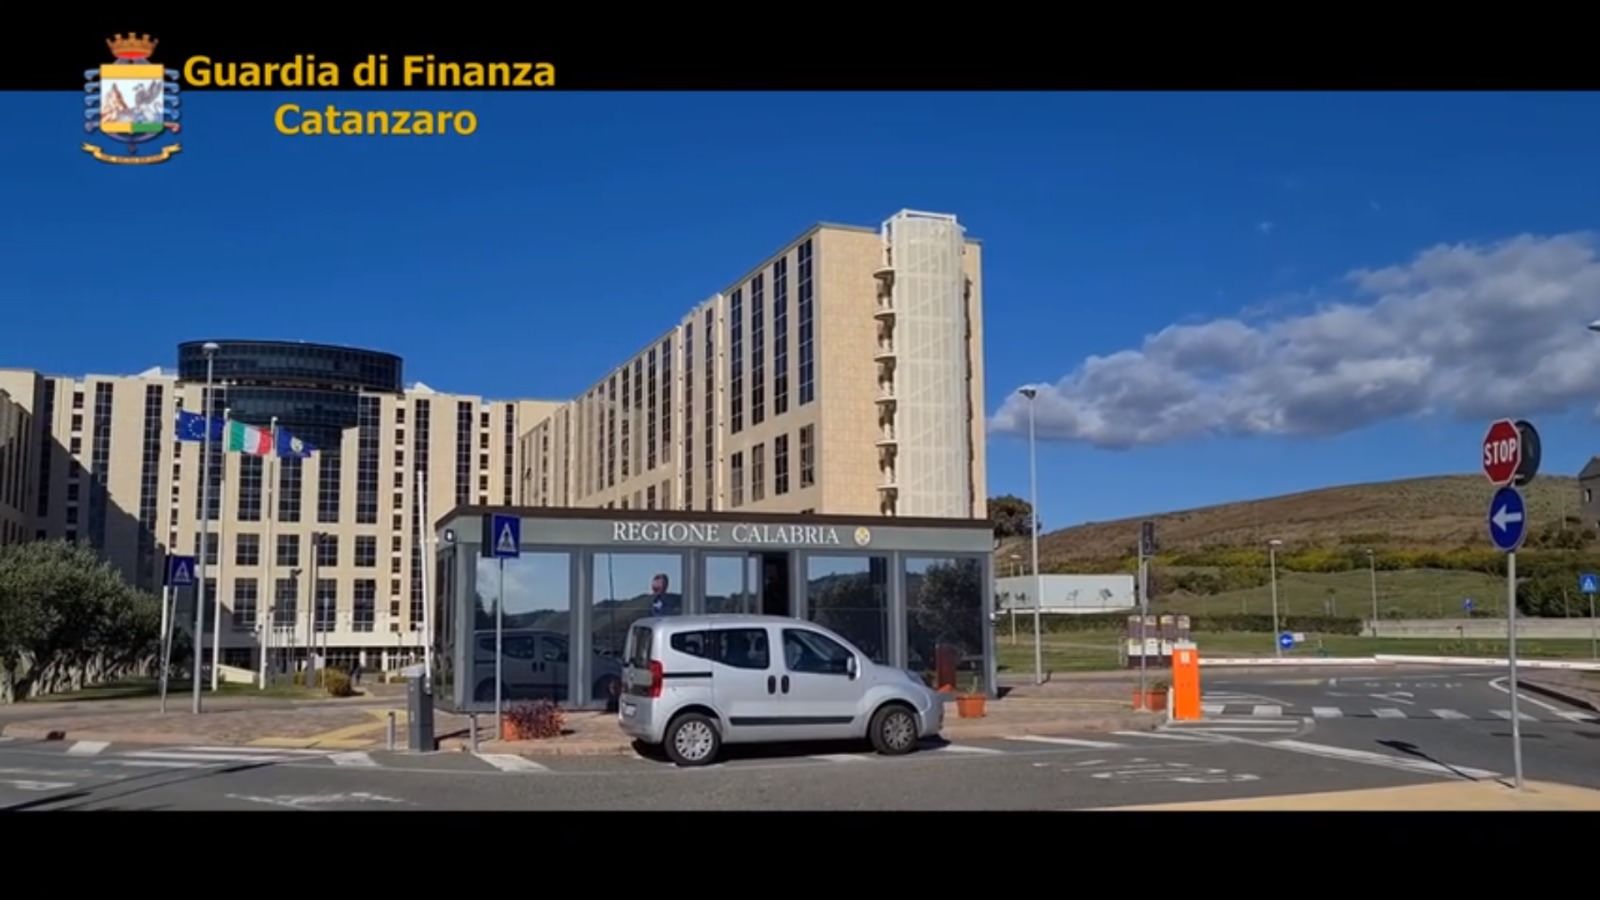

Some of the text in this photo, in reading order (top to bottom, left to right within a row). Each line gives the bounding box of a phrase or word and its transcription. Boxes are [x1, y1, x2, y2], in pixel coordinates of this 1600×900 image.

[1484, 437, 1517, 466] STOP
[612, 521, 840, 546] REGIONE CALABRIA
